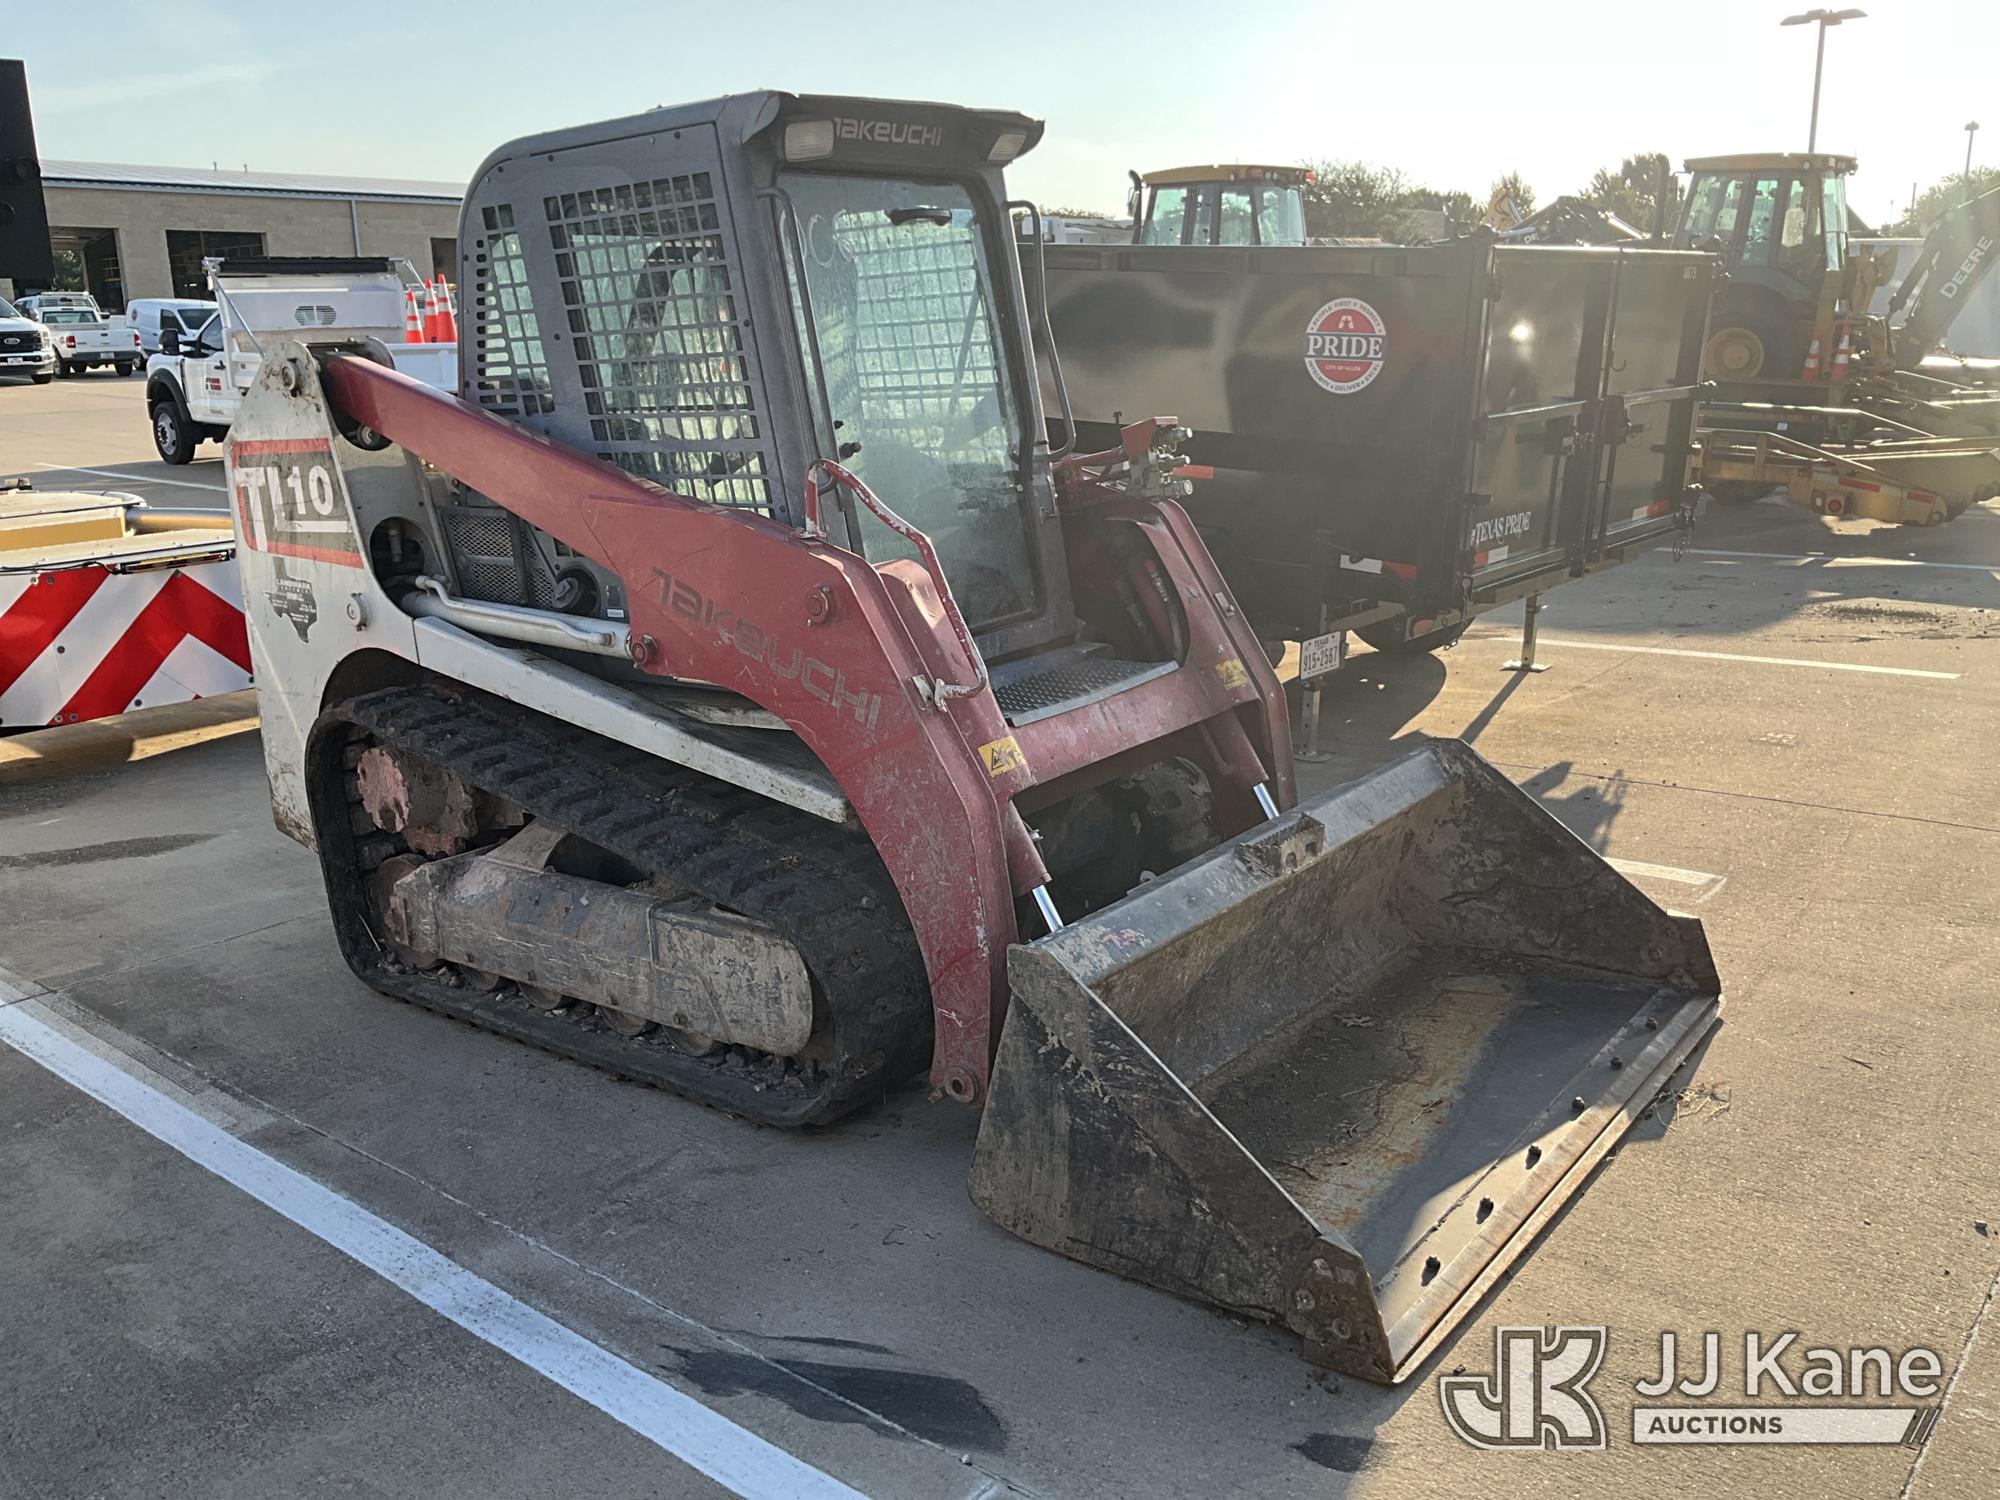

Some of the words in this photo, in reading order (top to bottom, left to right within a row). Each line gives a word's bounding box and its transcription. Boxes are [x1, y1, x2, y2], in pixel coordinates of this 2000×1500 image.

[1940, 235, 1993, 298] DEERE
[1306, 335, 1383, 358] PRIDE
[1334, 382, 1361, 392] DELIVER
[234, 465, 353, 552] TL10
[1475, 517, 1504, 547] TEXAS
[1504, 511, 1531, 537] PRIDE
